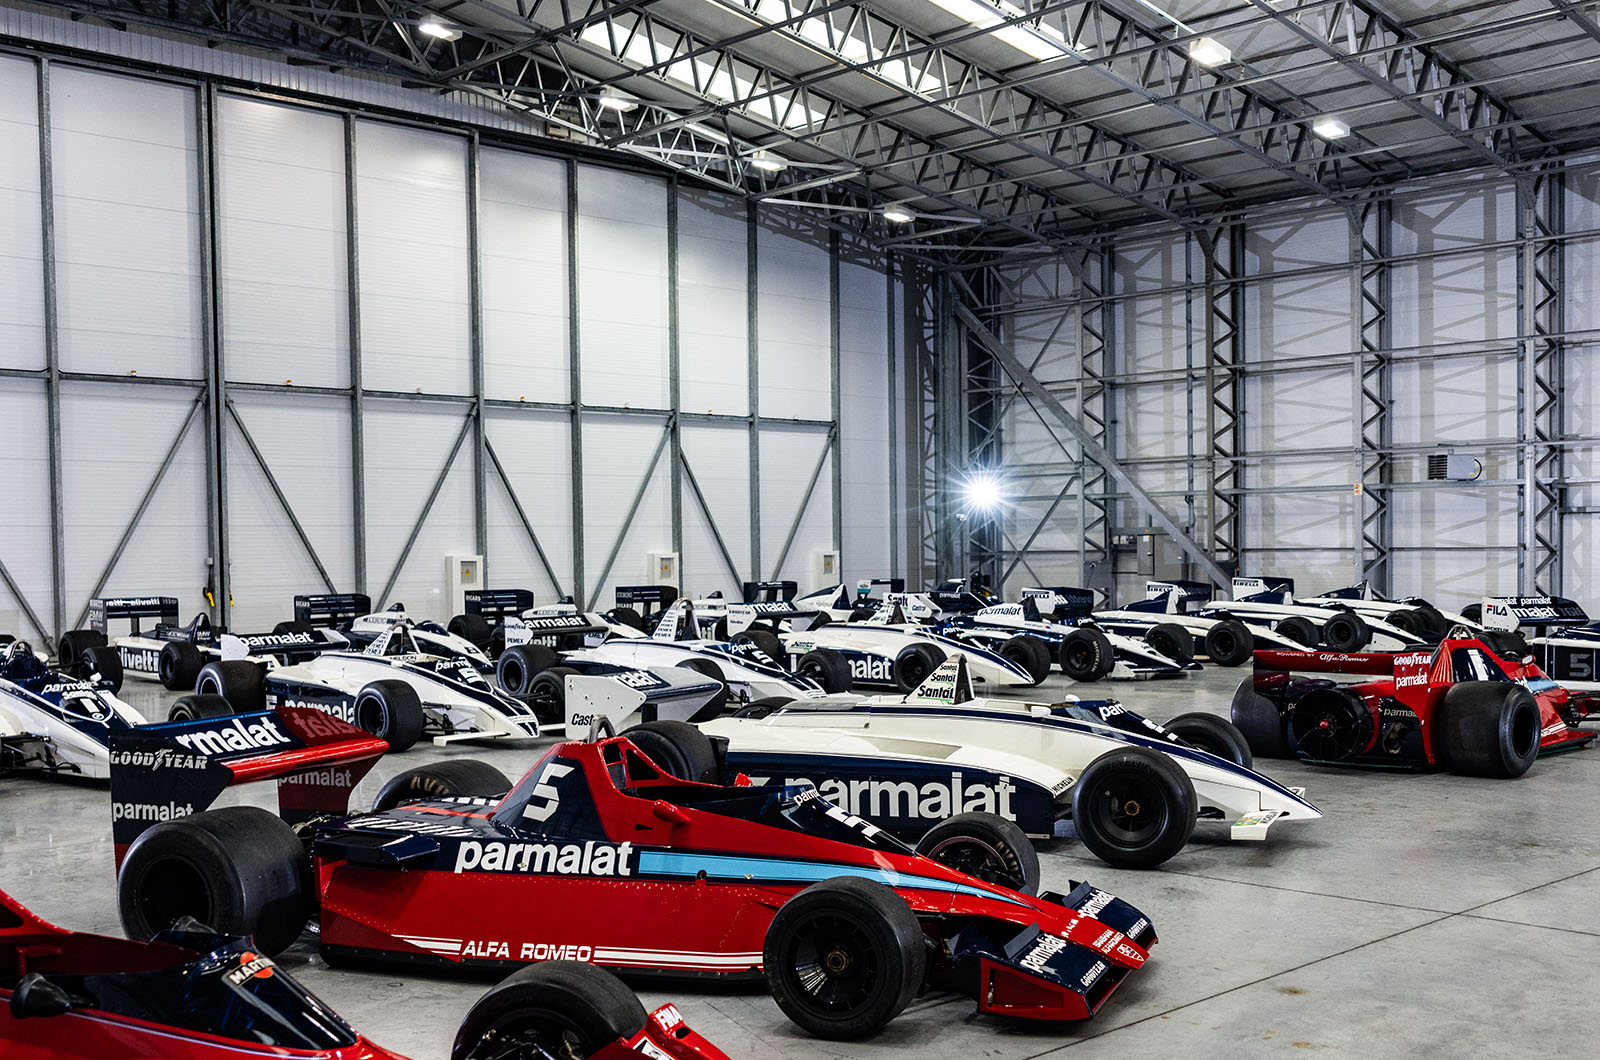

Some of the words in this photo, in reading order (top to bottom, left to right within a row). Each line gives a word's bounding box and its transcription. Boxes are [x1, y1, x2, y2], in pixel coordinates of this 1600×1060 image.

[979, 606, 1022, 616] parmalat
[1486, 604, 1508, 616] FILA
[1521, 597, 1552, 607] parmalat
[1569, 653, 1592, 678] 5
[1396, 672, 1428, 690] parmalat
[522, 763, 575, 822] 5
[1052, 776, 1075, 793] MICHELIN
[113, 801, 194, 822] parmalat
[454, 841, 633, 876] parmalat
[462, 940, 510, 958] ALFA
[520, 943, 592, 962] ROMEO
[1019, 932, 1067, 974] parmalat
